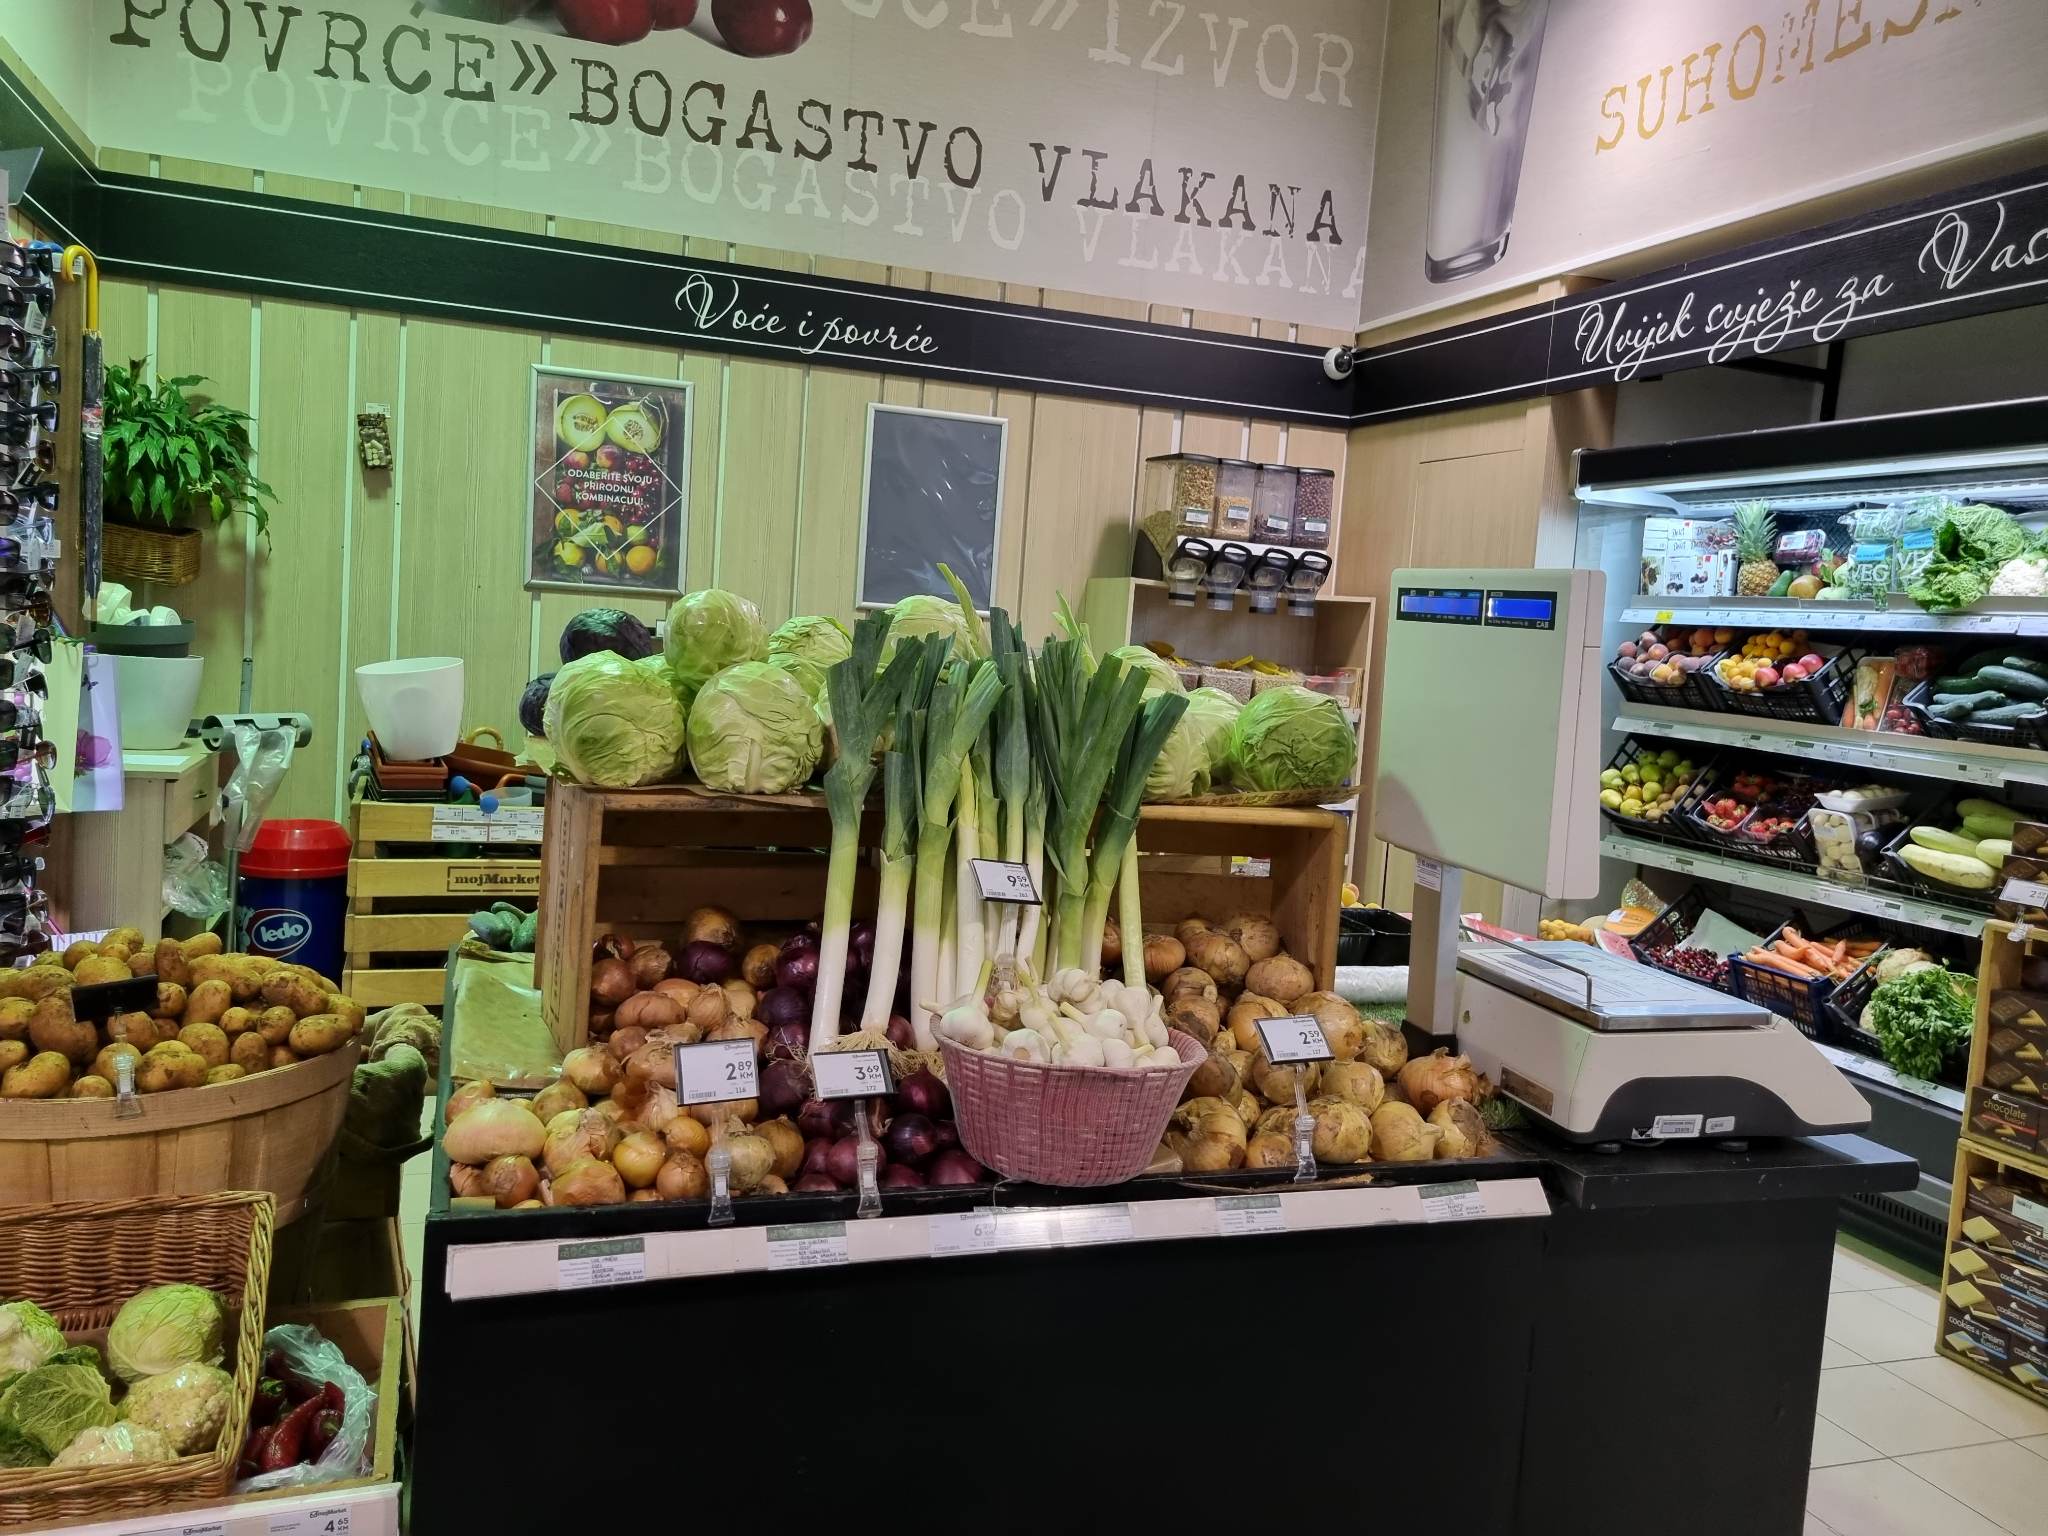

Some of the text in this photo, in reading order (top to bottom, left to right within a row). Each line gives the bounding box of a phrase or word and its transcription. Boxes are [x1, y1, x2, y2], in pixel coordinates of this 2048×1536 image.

[1029, 142, 1343, 245] VLAKANA
[675, 273, 940, 354] Voće i povrće
[1575, 291, 1695, 382] Uvijek
[1704, 282, 1823, 364] svježe
[1814, 273, 1894, 342] za
[567, 468, 653, 485] ODABERITE SVOJU
[584, 480, 634, 494] PRIRODNU
[454, 873, 540, 886] mojMarket
[1007, 875, 1017, 887] 9
[260, 922, 304, 943] ledo
[1299, 1031, 1311, 1045] 2
[725, 1060, 752, 1081] 2 89
[740, 1071, 754, 1080] KM
[854, 1064, 880, 1081] 3 69
[1983, 1099, 2027, 1120] chocolate
[1948, 1315, 1974, 1333] cookies
[324, 1517, 349, 1533] 4 65
